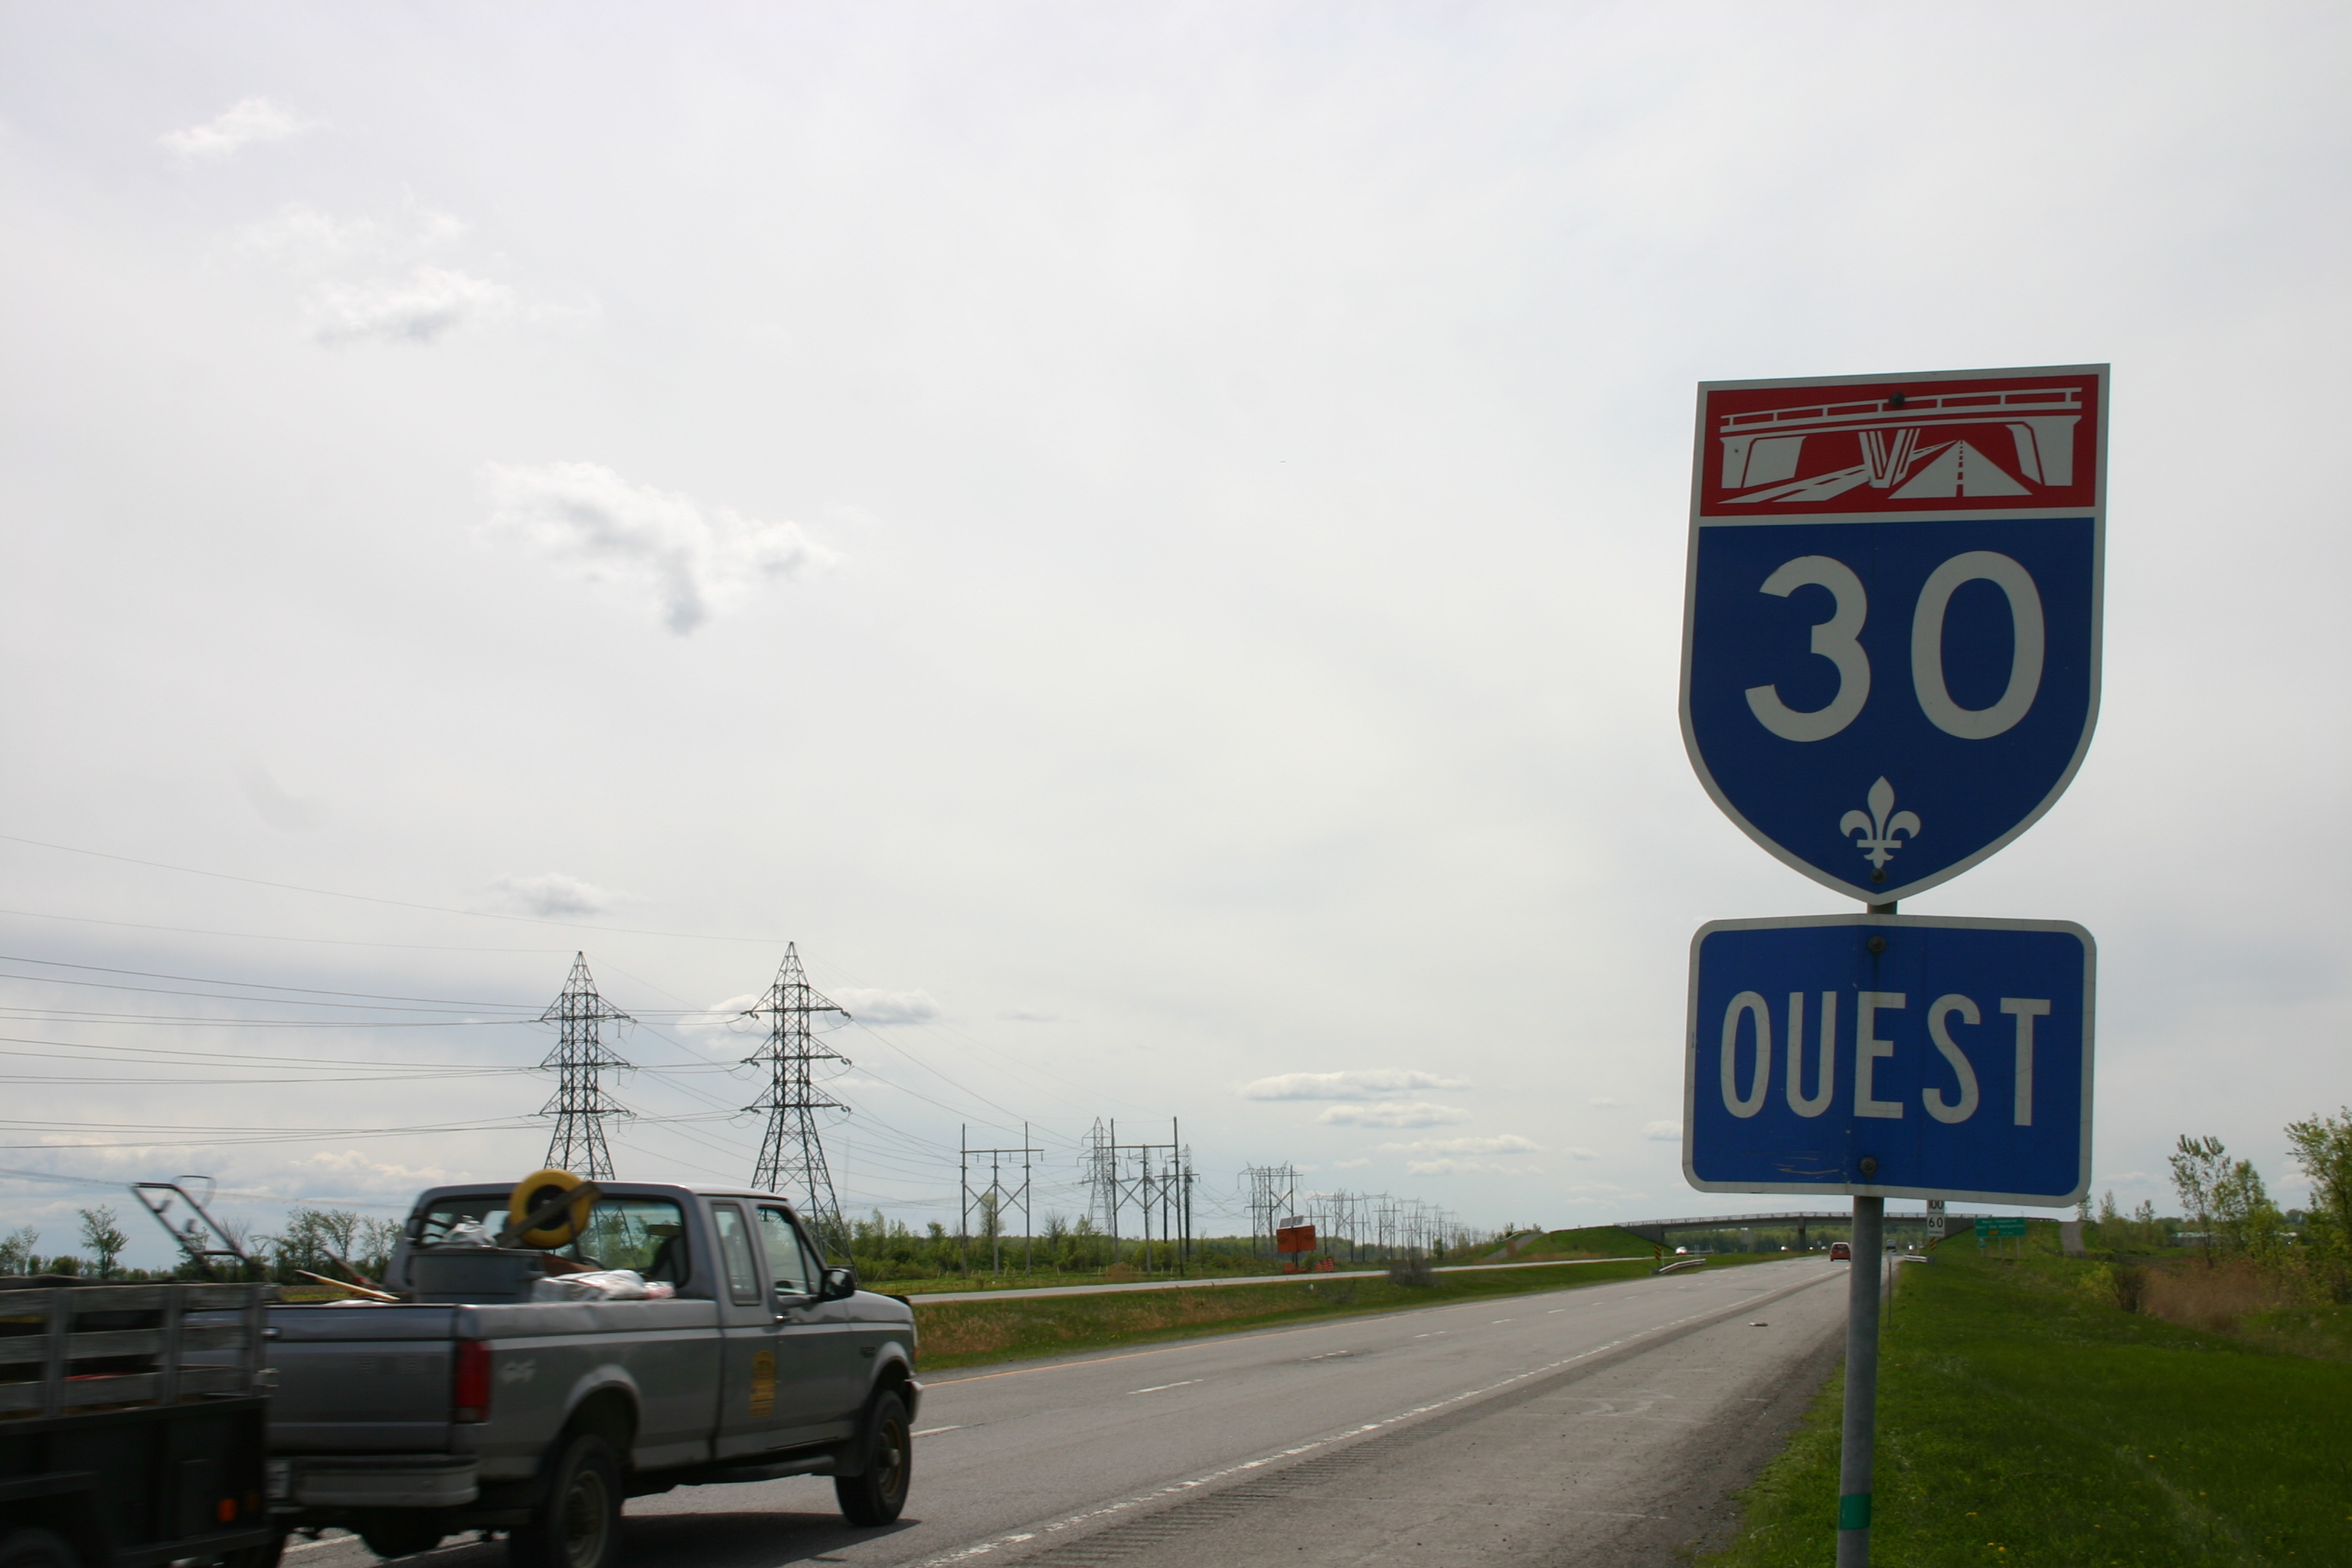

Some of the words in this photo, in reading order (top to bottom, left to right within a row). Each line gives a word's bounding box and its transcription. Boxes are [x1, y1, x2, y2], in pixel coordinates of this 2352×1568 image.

[1745, 550, 2045, 743] 30
[1720, 991, 2051, 1126] OUEST
[1928, 1200, 1944, 1210] 100
[1928, 1217, 1943, 1228] 60
